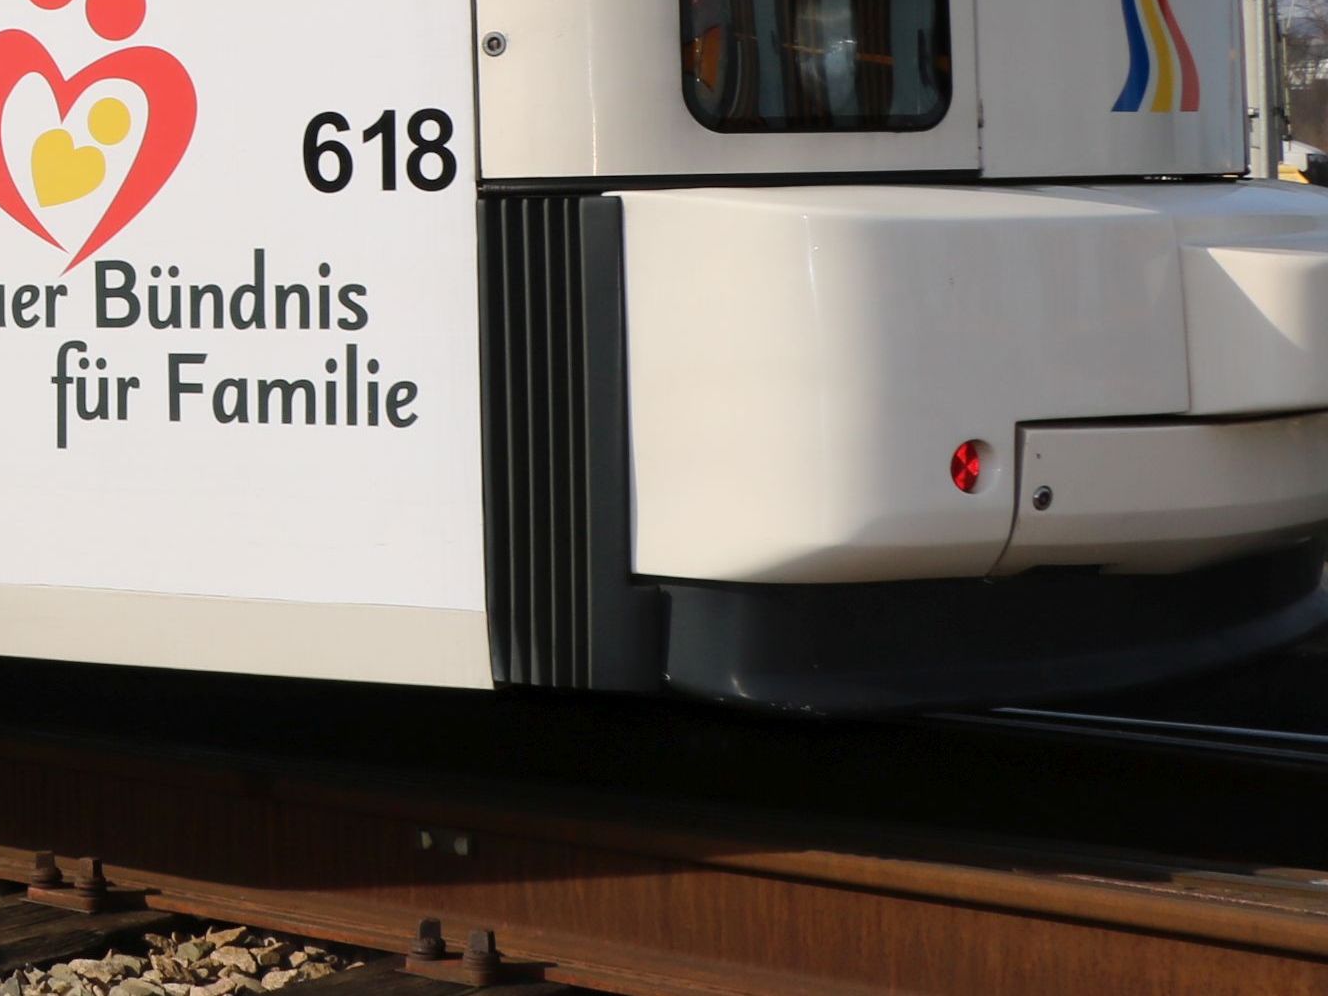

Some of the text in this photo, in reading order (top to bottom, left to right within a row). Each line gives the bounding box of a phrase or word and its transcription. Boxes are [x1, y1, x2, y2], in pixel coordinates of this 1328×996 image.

[302, 107, 458, 194] 618
[94, 248, 369, 332] Bündnis
[51, 340, 419, 449] für Familie
